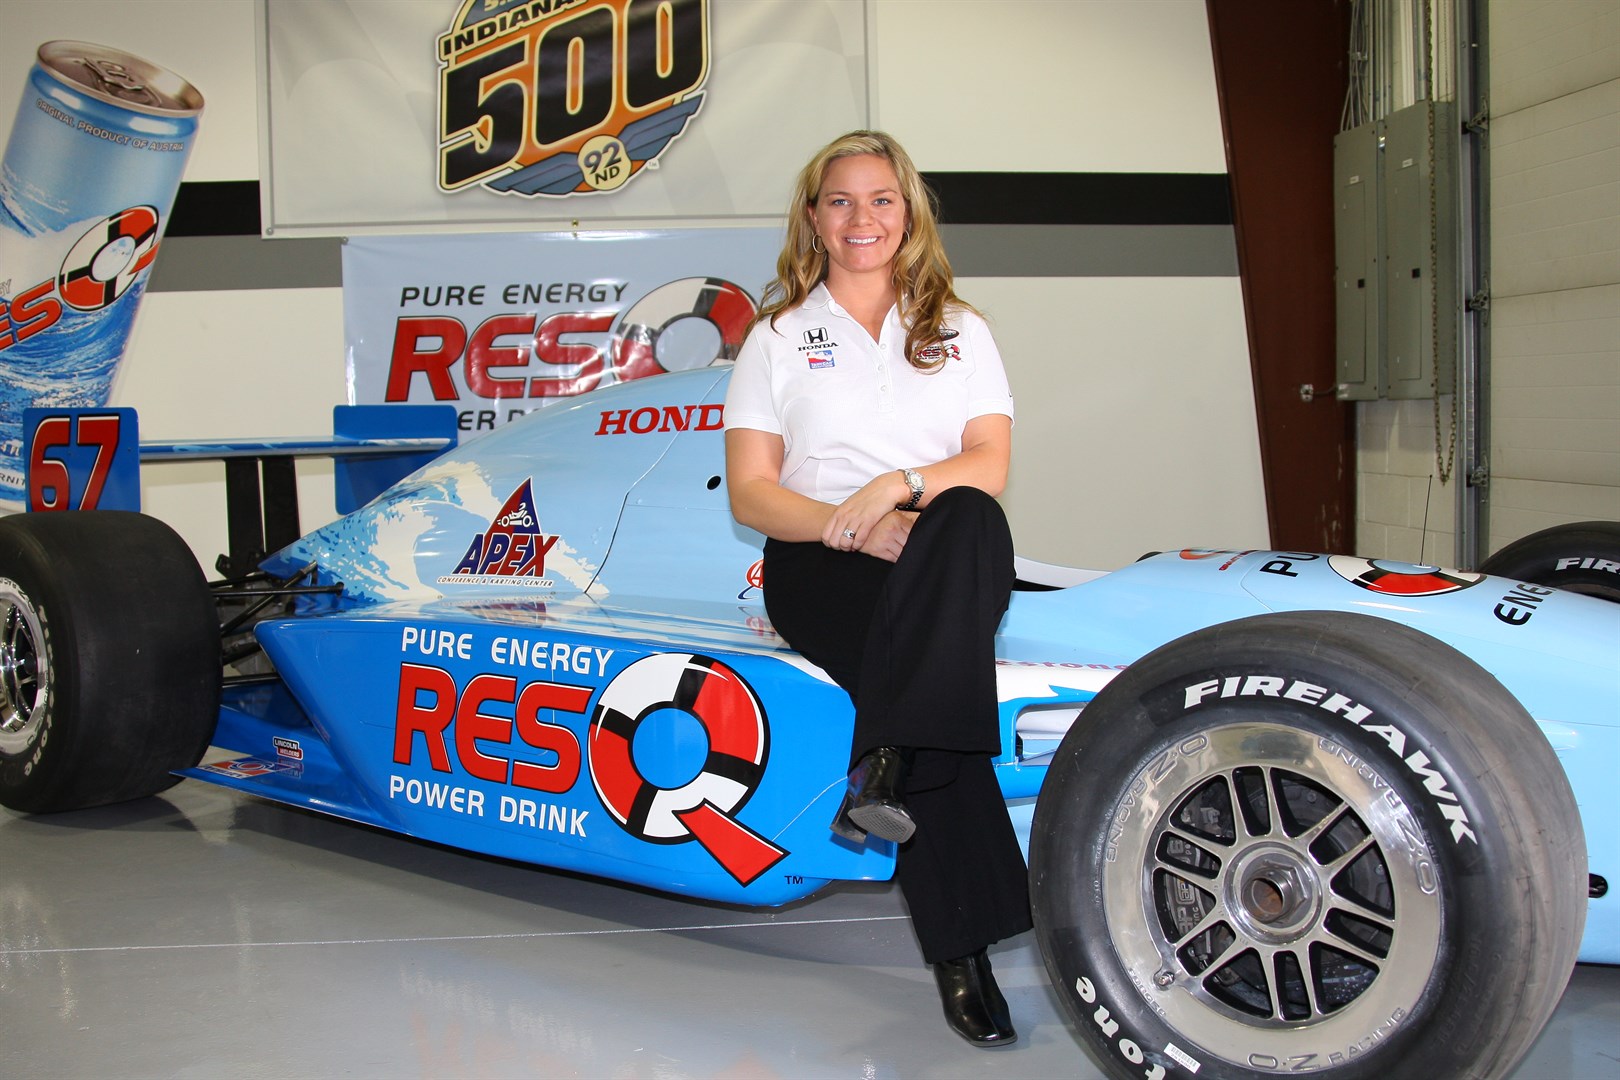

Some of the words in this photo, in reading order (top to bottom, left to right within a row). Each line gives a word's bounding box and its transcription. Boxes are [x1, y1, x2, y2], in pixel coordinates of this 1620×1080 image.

[444, 0, 703, 187] 500
[37, 99, 74, 127] ORIGINAL
[77, 121, 129, 144] PRODUCT
[132, 138, 149, 149] OF
[149, 141, 184, 151] AUSTRIA
[584, 141, 622, 175] 92
[595, 165, 621, 185] ND
[400, 285, 486, 307] PURE
[502, 282, 629, 304] ENERGY
[798, 342, 839, 351] HONDA
[29, 413, 120, 512] 67
[437, 576, 480, 584] CONFERENCE
[524, 579, 553, 587] CENTER
[451, 533, 559, 578] APEX
[402, 626, 473, 660] PURE
[491, 636, 614, 678] ENERGY
[274, 738, 298, 750] LINCOLN
[279, 749, 301, 758] WELDERS
[393, 652, 791, 888] RESQ
[1184, 675, 1478, 846] FIREHAWK
[1319, 737, 1402, 809] RACING
[389, 775, 485, 817] POWER
[499, 797, 589, 838] DRINK
[1106, 779, 1148, 862] RACING
[785, 876, 804, 885] TM
[1328, 1006, 1407, 1066] RACING
